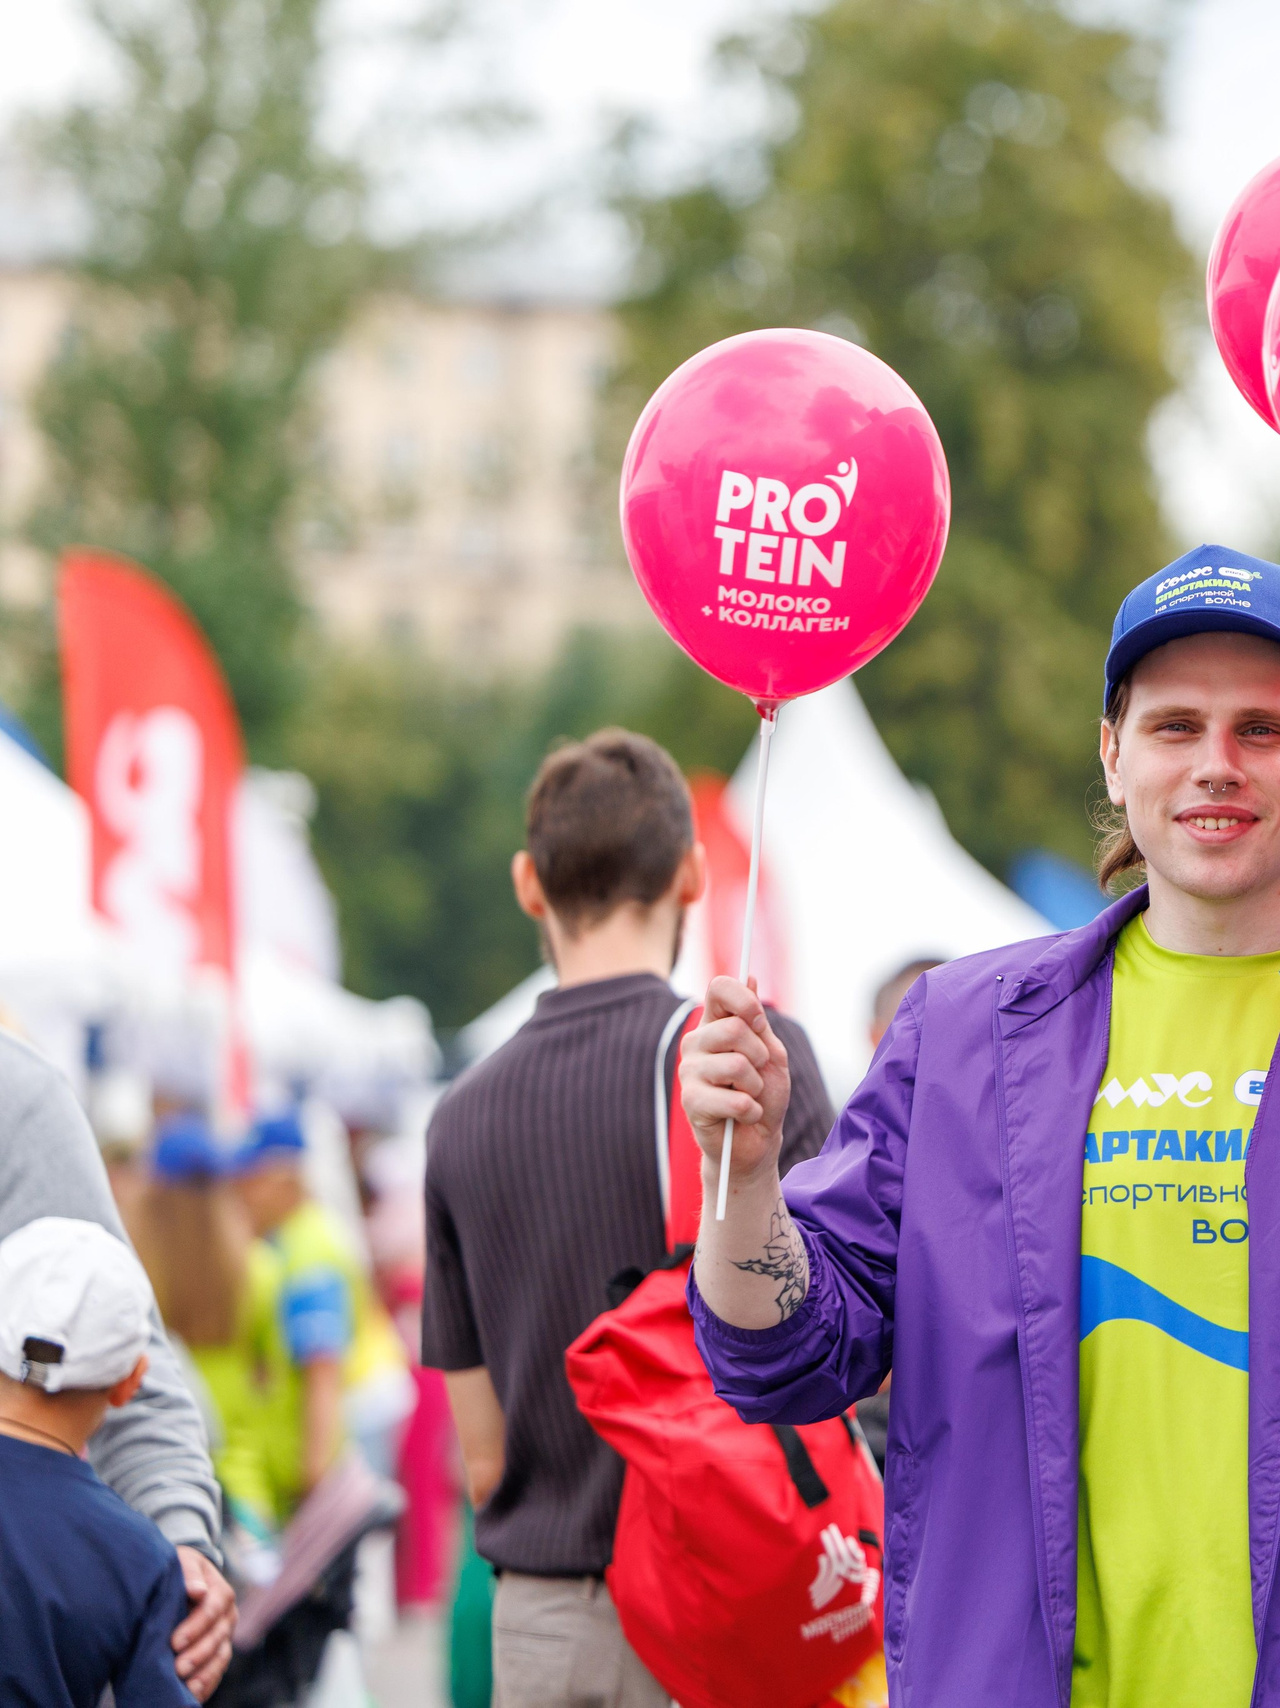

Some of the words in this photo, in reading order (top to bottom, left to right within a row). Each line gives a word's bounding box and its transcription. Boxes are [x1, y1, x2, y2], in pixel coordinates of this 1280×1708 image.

[716, 470, 841, 537] PRO
[713, 525, 846, 588] TEIN
[718, 586, 831, 614] МОЛОКО
[1155, 579, 1251, 605] СПАРТАКИАДА
[1169, 589, 1235, 607] спортивной
[718, 606, 850, 633] КОЛЛАГЕН
